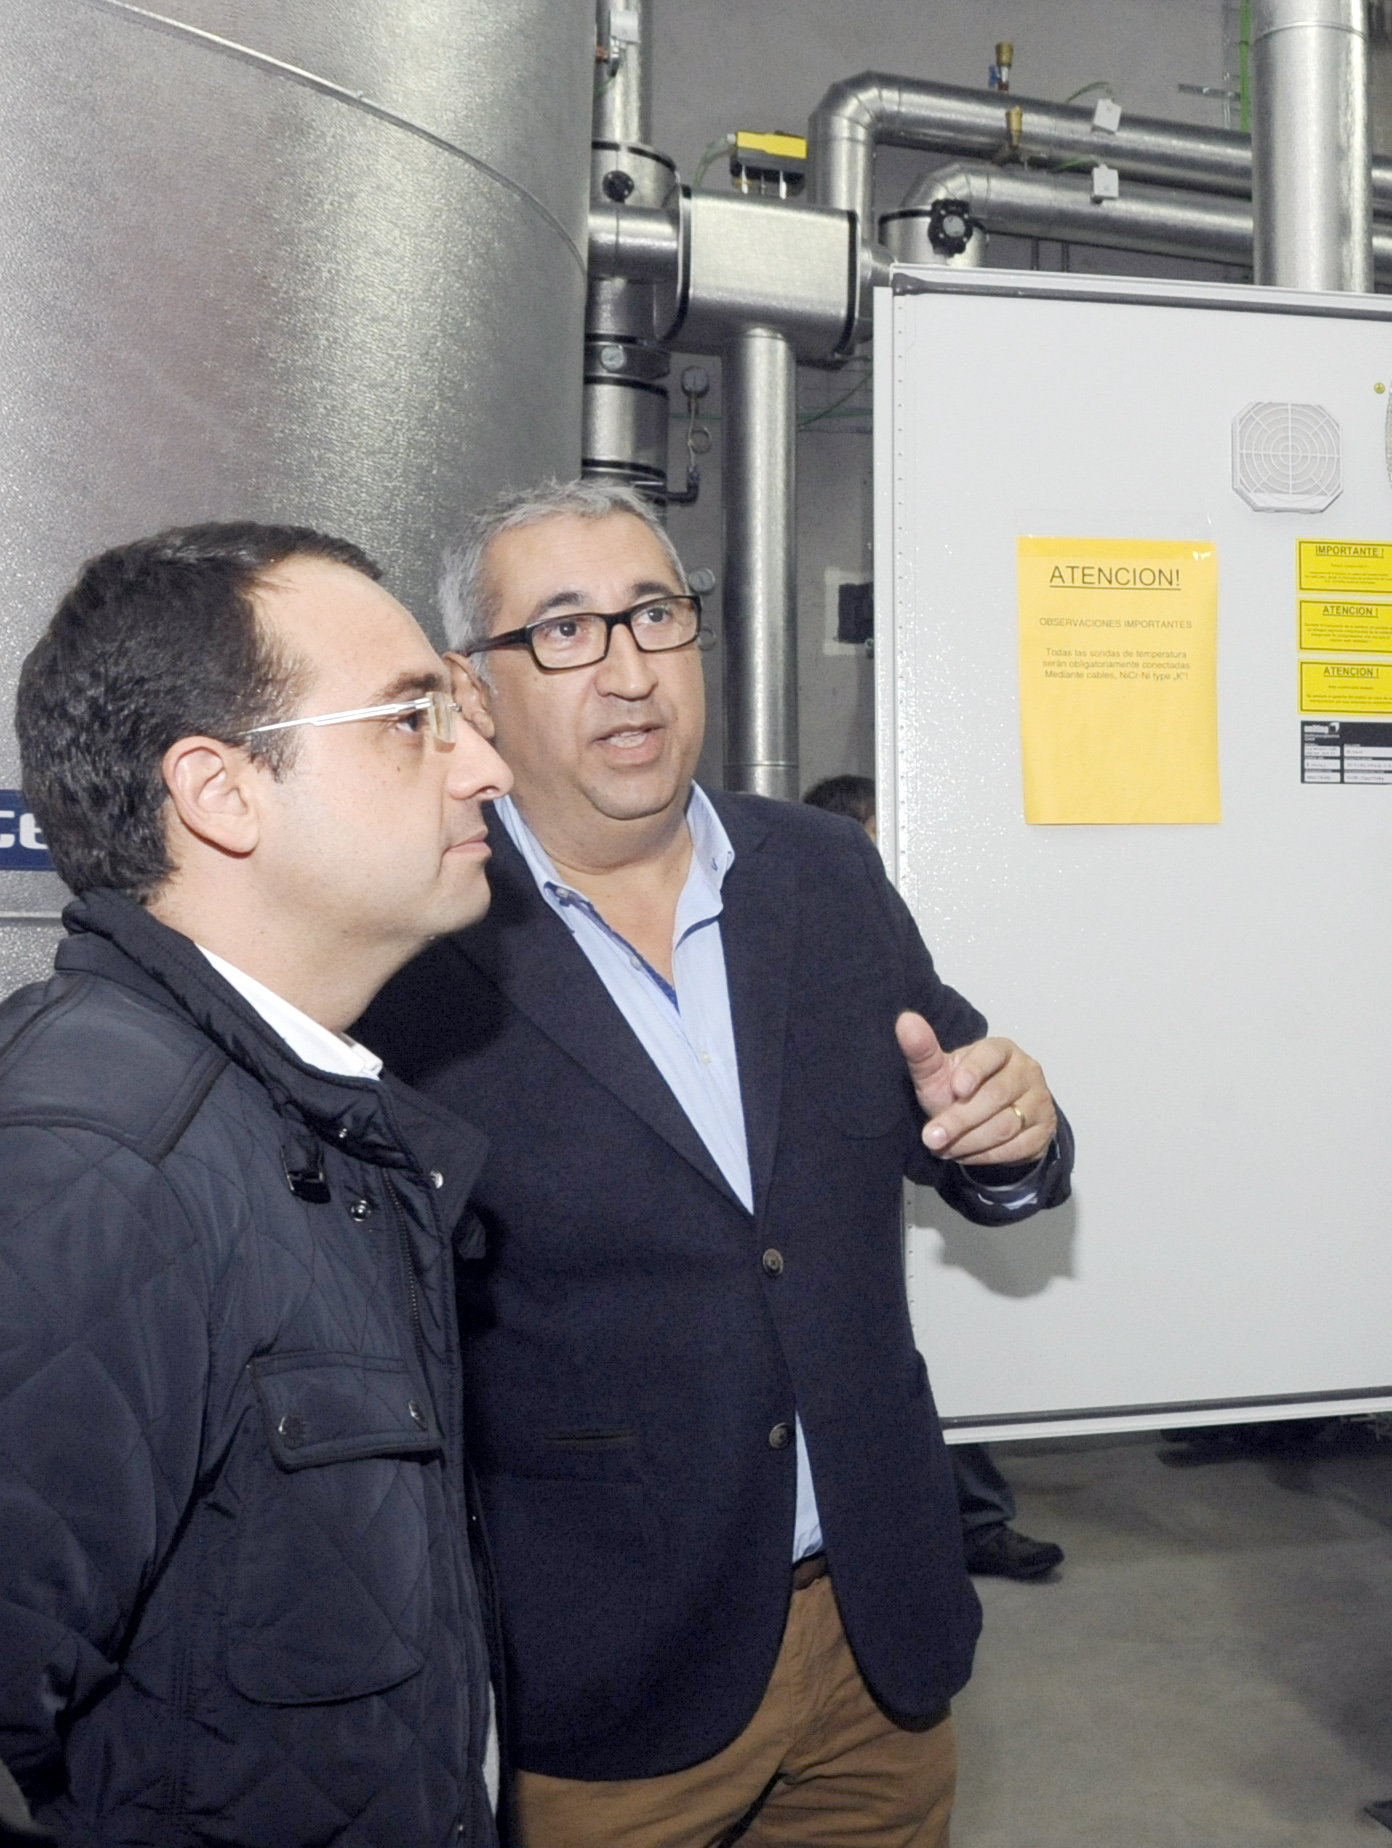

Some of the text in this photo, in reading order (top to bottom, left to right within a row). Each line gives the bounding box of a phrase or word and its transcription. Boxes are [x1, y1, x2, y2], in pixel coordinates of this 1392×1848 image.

[1315, 546, 1379, 556] IMPORTANTE
[1049, 565, 1180, 587] ATENCION!
[1322, 605, 1373, 616] ATENCION
[1039, 617, 1193, 629] OBSERVACIONES IMPORTANTES
[1046, 647, 1187, 659] Todas las sondas de temperatura
[1142, 661, 1190, 670] conectadas
[1044, 669, 1085, 679] Mediante
[1152, 671, 1171, 682] type
[1323, 666, 1374, 677] ATENCION
